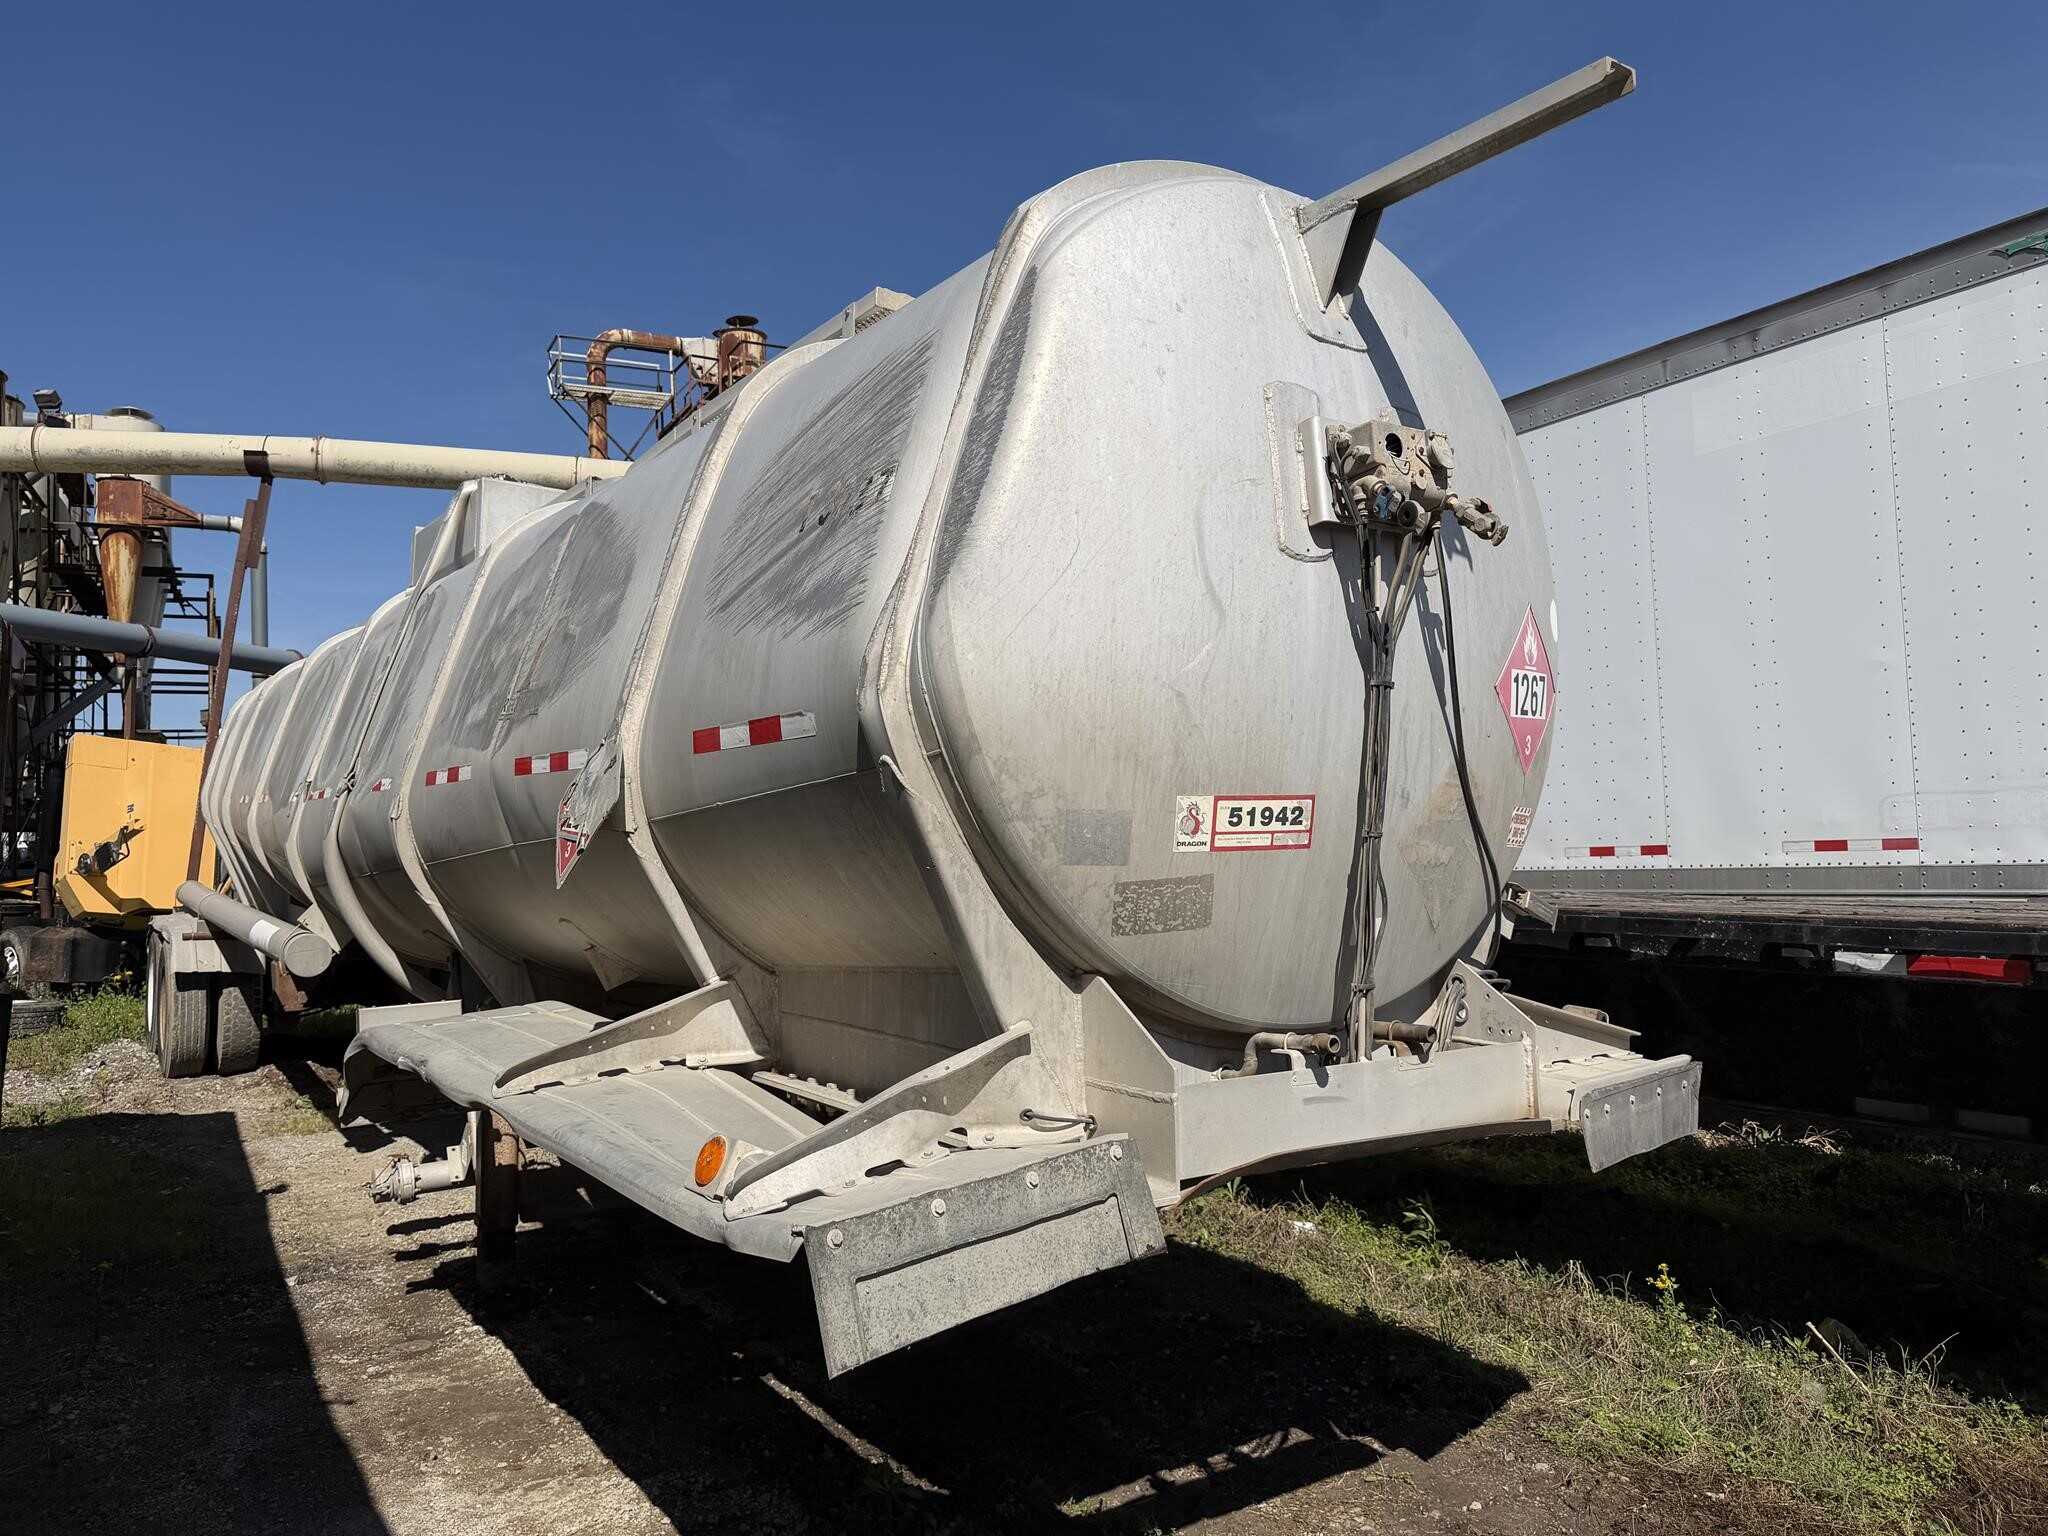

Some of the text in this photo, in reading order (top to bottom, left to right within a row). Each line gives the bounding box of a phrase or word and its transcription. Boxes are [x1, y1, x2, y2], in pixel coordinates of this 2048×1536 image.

[1513, 672, 1546, 717] 1267
[1525, 735, 1532, 755] 3
[1227, 806, 1304, 827] 51942
